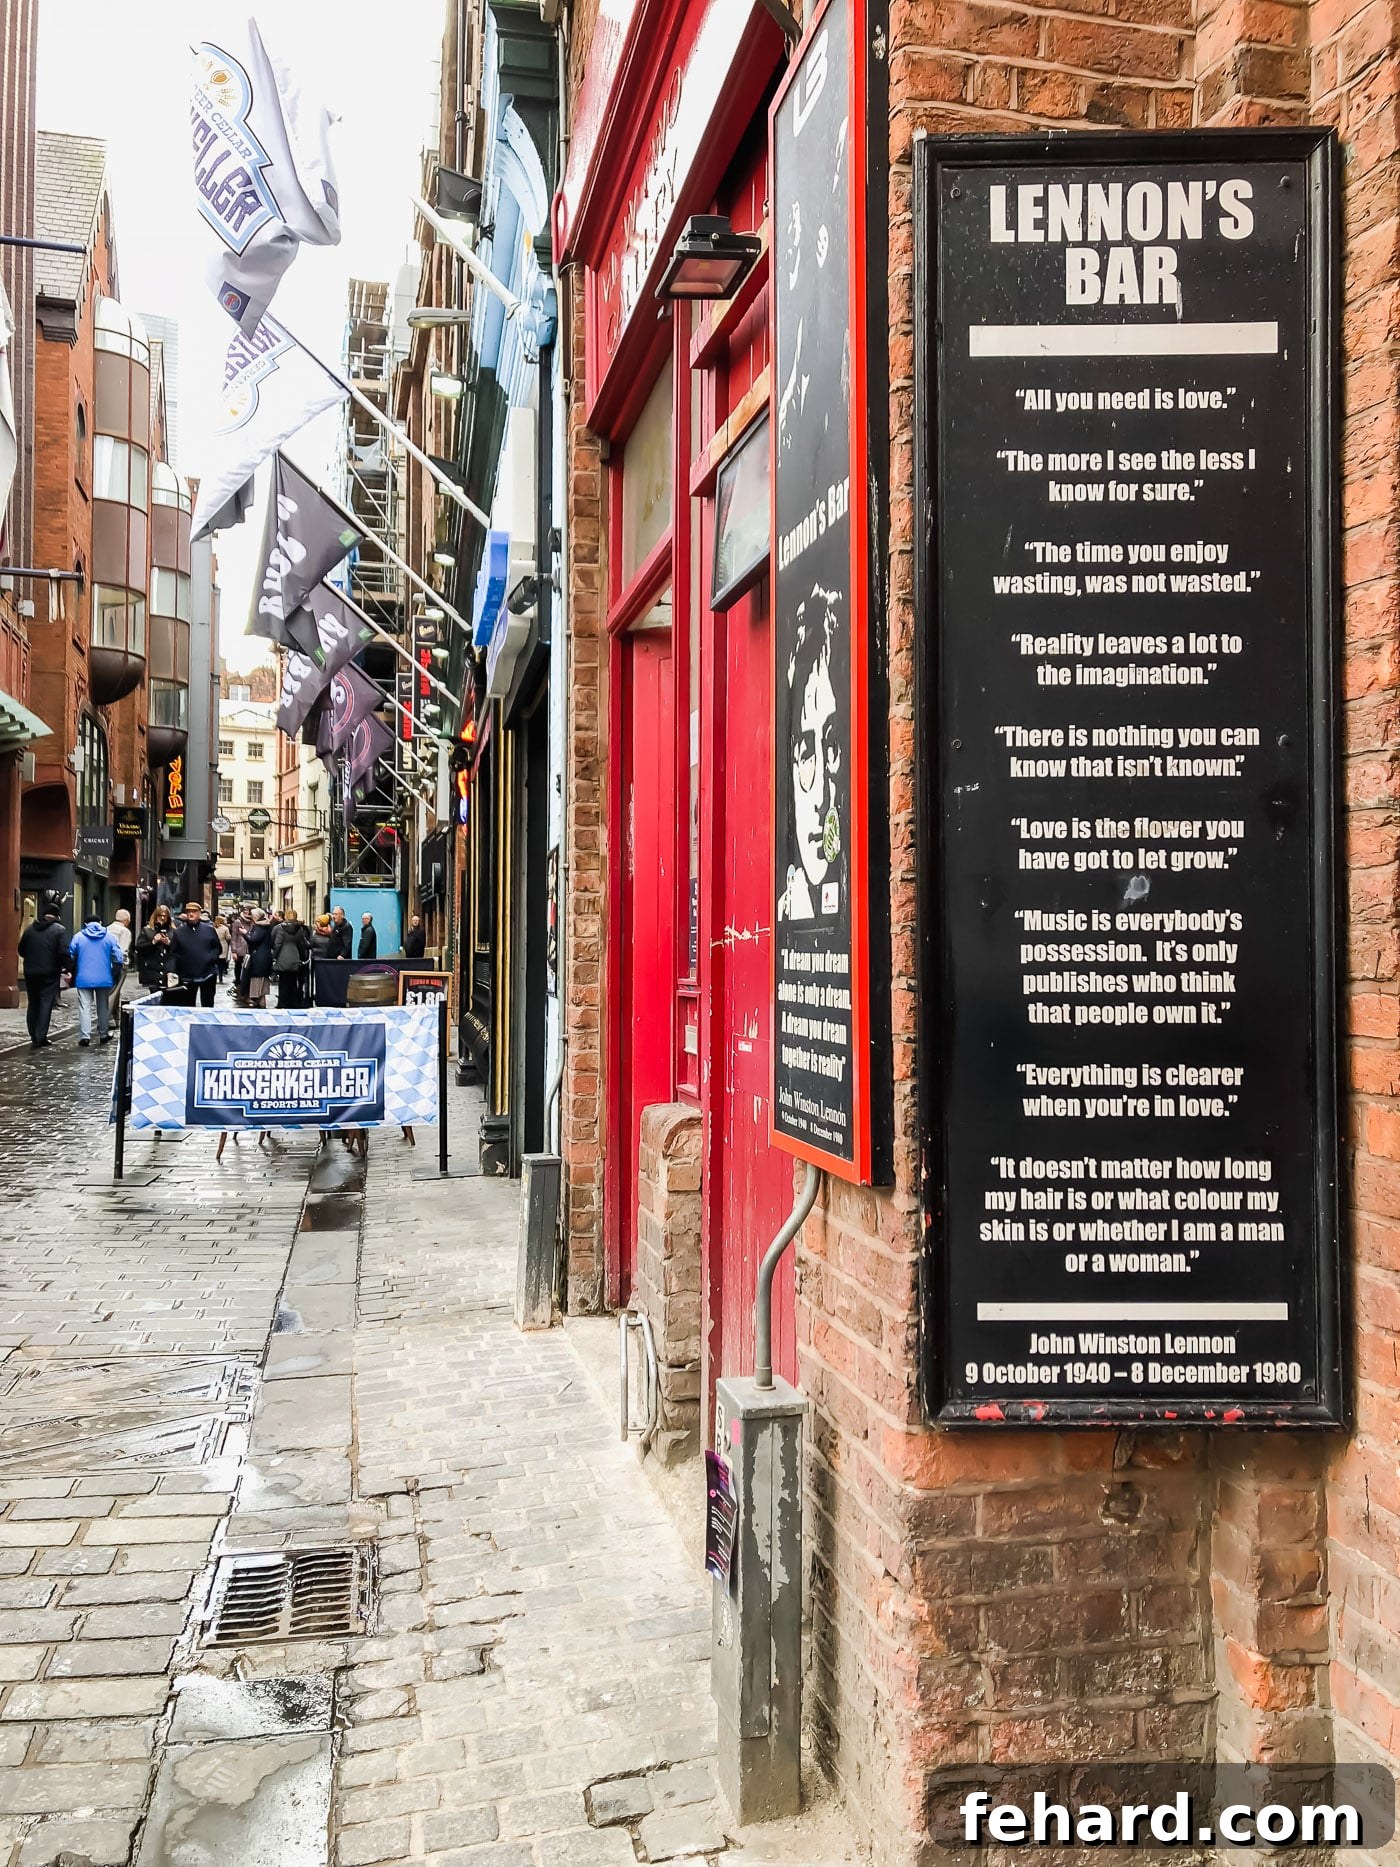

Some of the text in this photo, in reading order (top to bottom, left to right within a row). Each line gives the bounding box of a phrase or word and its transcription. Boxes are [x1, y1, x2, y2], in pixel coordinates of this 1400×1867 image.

[211, 111, 252, 160] CELLAR
[990, 179, 1254, 242] LENNON’S
[1066, 246, 1179, 305] BAR
[1016, 388, 1236, 412] “All you need is love.”
[997, 449, 1255, 471] “The more I see the less I
[827, 475, 850, 528] Bar
[1049, 480, 1203, 501] know for sure.”
[1025, 541, 1228, 564] “The time you enjoy
[993, 571, 1260, 596] wasting, was not wasted.”
[1011, 633, 1242, 656] “Reality leaves a lot to
[1037, 663, 1217, 687] the imagination.”
[995, 725, 1259, 748] “There is nothing you can
[1011, 755, 1244, 777] know that isn’t known.”
[1011, 818, 1244, 840] “Love is the flower you
[1019, 848, 1237, 871] have got to let grow.”
[1015, 909, 1242, 932] “Music is everybody’s
[789, 949, 811, 971] dream
[811, 953, 824, 973] you
[825, 950, 849, 973] dream
[1021, 940, 1237, 963] possession. It’s only
[1023, 971, 1235, 994] publishes who think
[778, 980, 851, 1010] alone is only a dream.
[1028, 1002, 1230, 1025] that people own it.”
[782, 1011, 847, 1045] A dream you dream
[234, 1058, 341, 1068] GERMAN BEER CELLAR
[782, 1043, 810, 1071] together
[811, 1048, 817, 1073] is
[204, 1067, 370, 1100] KAISERKELLER
[1017, 1064, 1243, 1088] “Everything is clearer
[253, 1099, 320, 1109] & SPORTS BAR
[779, 1086, 847, 1127] John Winston Lennon
[1023, 1095, 1237, 1118] when you’re in love.”
[991, 1157, 1271, 1181] “It doesn’t matter how long
[985, 1188, 1279, 1211] my hair is or what colour my
[980, 1219, 1284, 1241] skin is or whether I am a man
[1066, 1250, 1199, 1272] or a woman.”
[1030, 1333, 1235, 1354] John Winston Lennon
[966, 1363, 978, 1383] 9
[983, 1363, 1060, 1383] October
[1064, 1362, 1110, 1383] 1940
[1132, 1362, 1143, 1383] 8
[1149, 1363, 1249, 1383] December
[1253, 1362, 1300, 1383] 1980
